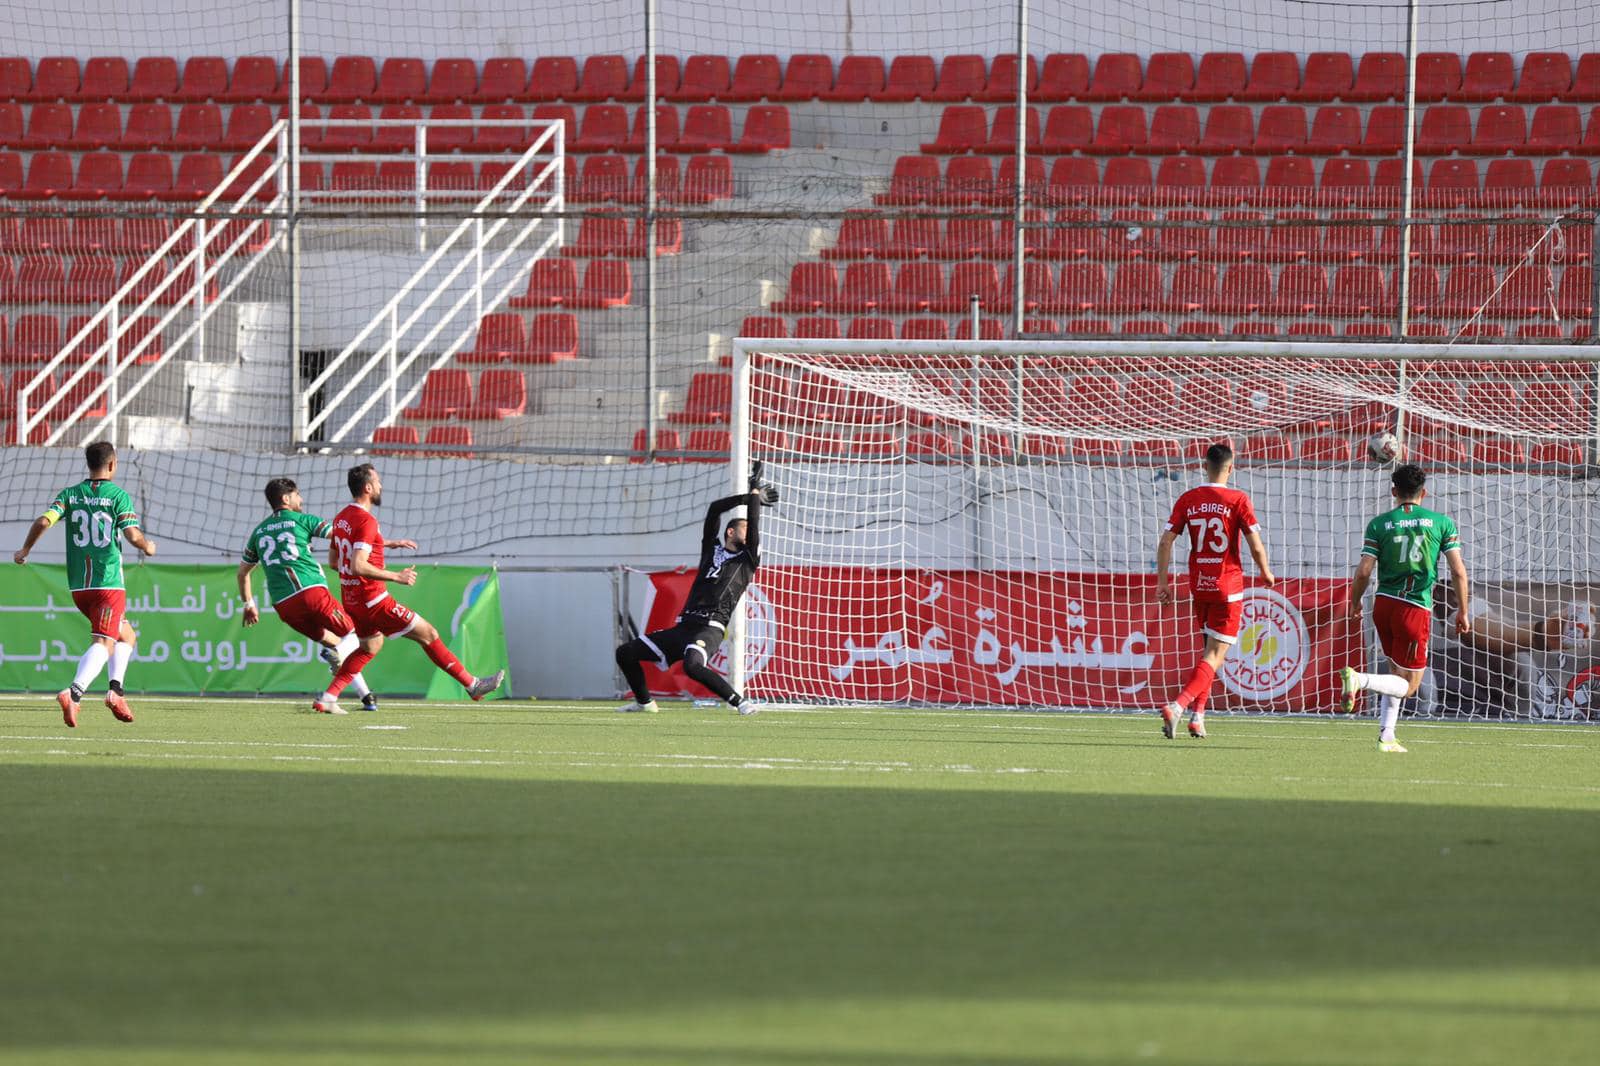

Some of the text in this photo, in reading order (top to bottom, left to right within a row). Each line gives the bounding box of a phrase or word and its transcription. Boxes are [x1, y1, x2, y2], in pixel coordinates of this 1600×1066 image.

[1187, 503, 1231, 518] AL-BIREH
[71, 509, 113, 548] 30
[1190, 517, 1229, 553] 73
[259, 532, 299, 566] 23
[1393, 535, 1425, 563] 76
